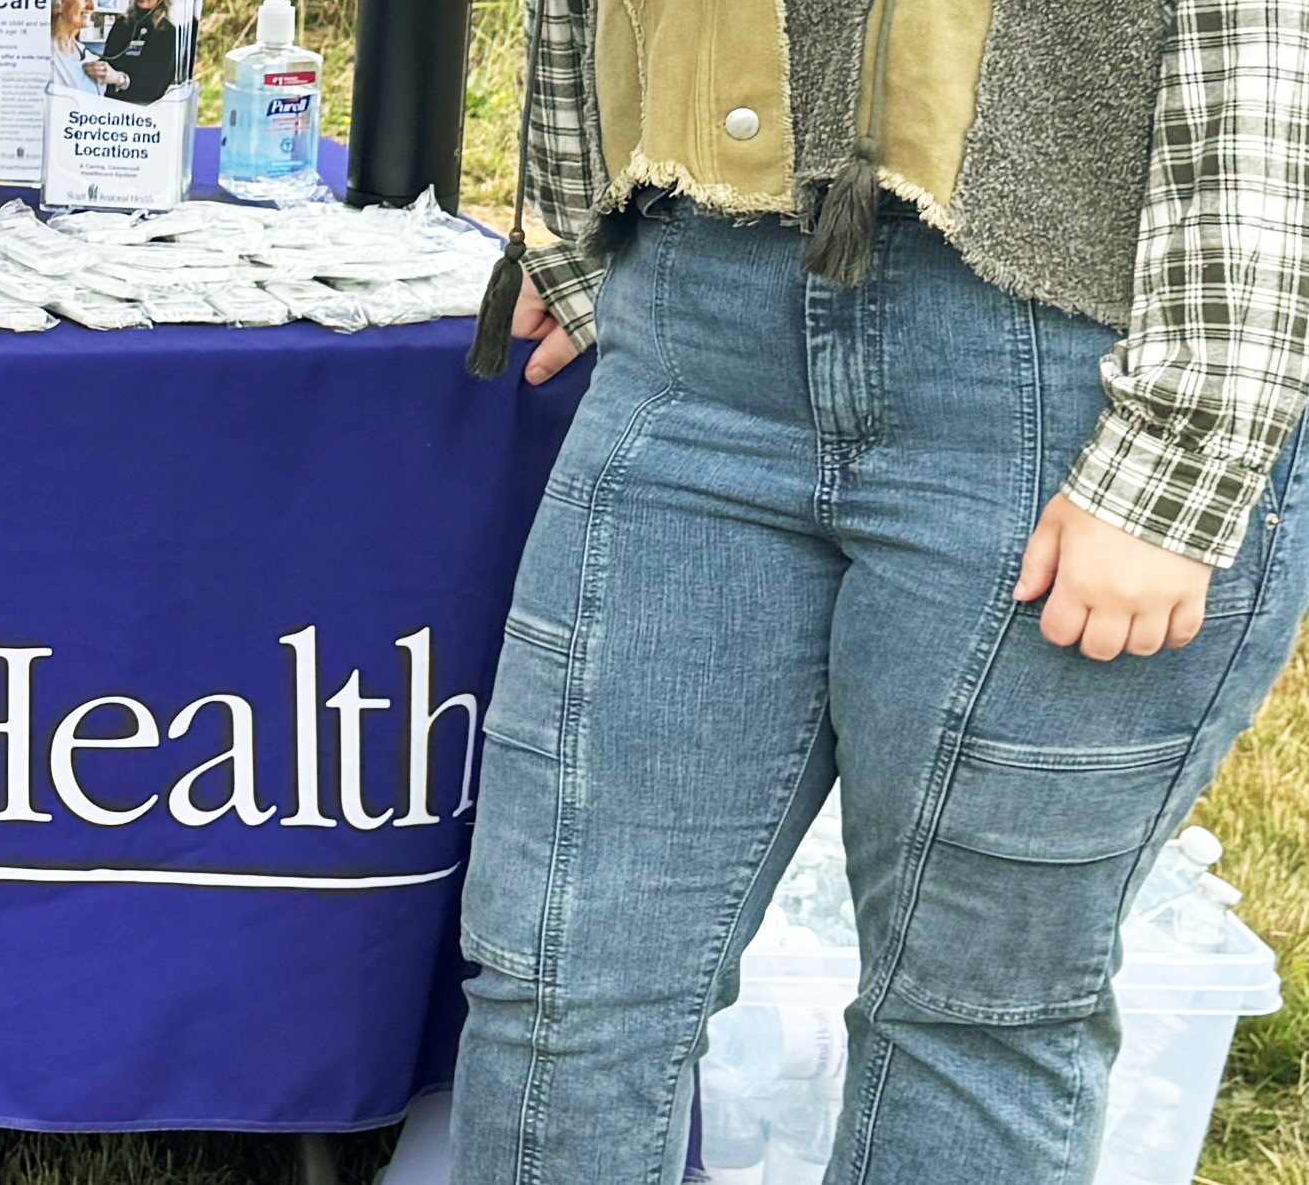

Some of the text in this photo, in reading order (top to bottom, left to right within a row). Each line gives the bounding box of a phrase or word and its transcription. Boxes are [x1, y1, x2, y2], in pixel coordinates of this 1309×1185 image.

[69, 111, 157, 129] Specialties,
[64, 126, 160, 143] Services and
[74, 142, 149, 159] Locations
